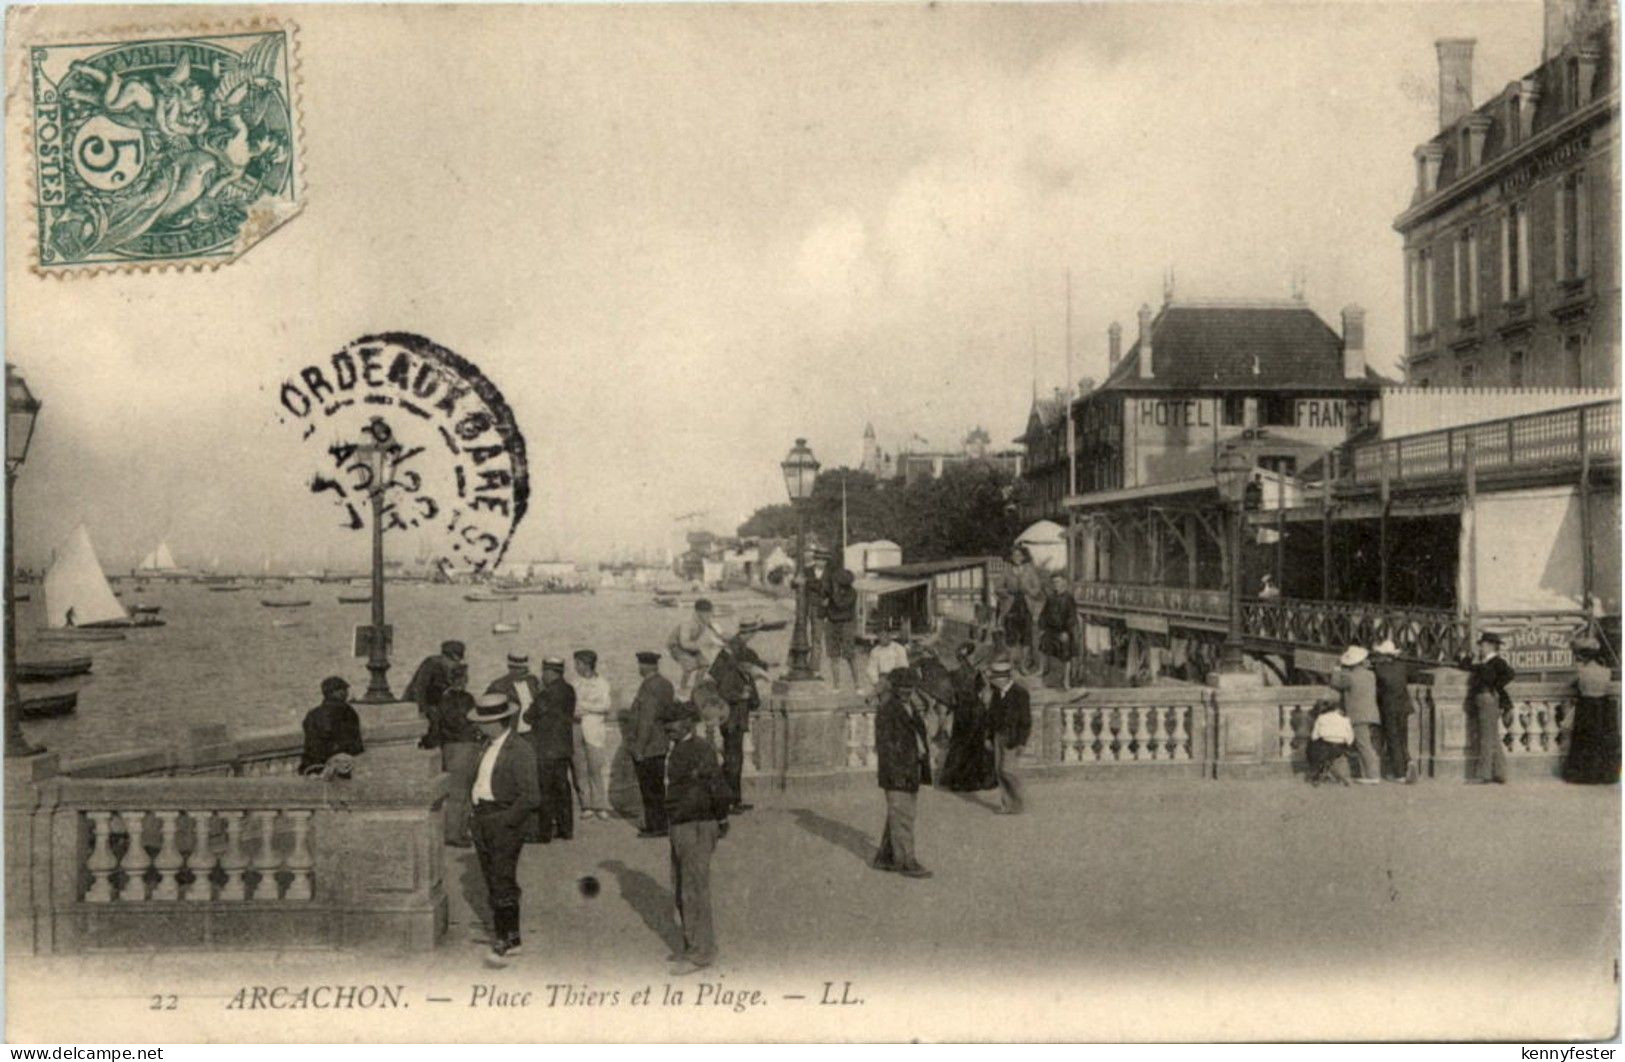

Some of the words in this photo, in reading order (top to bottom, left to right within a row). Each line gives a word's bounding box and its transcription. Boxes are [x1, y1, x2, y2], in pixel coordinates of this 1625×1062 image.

[37, 104, 63, 203] POSTES
[280, 348, 469, 419] ORDEAUX
[1141, 401, 1210, 427] HOTEL
[1242, 429, 1270, 441] DE
